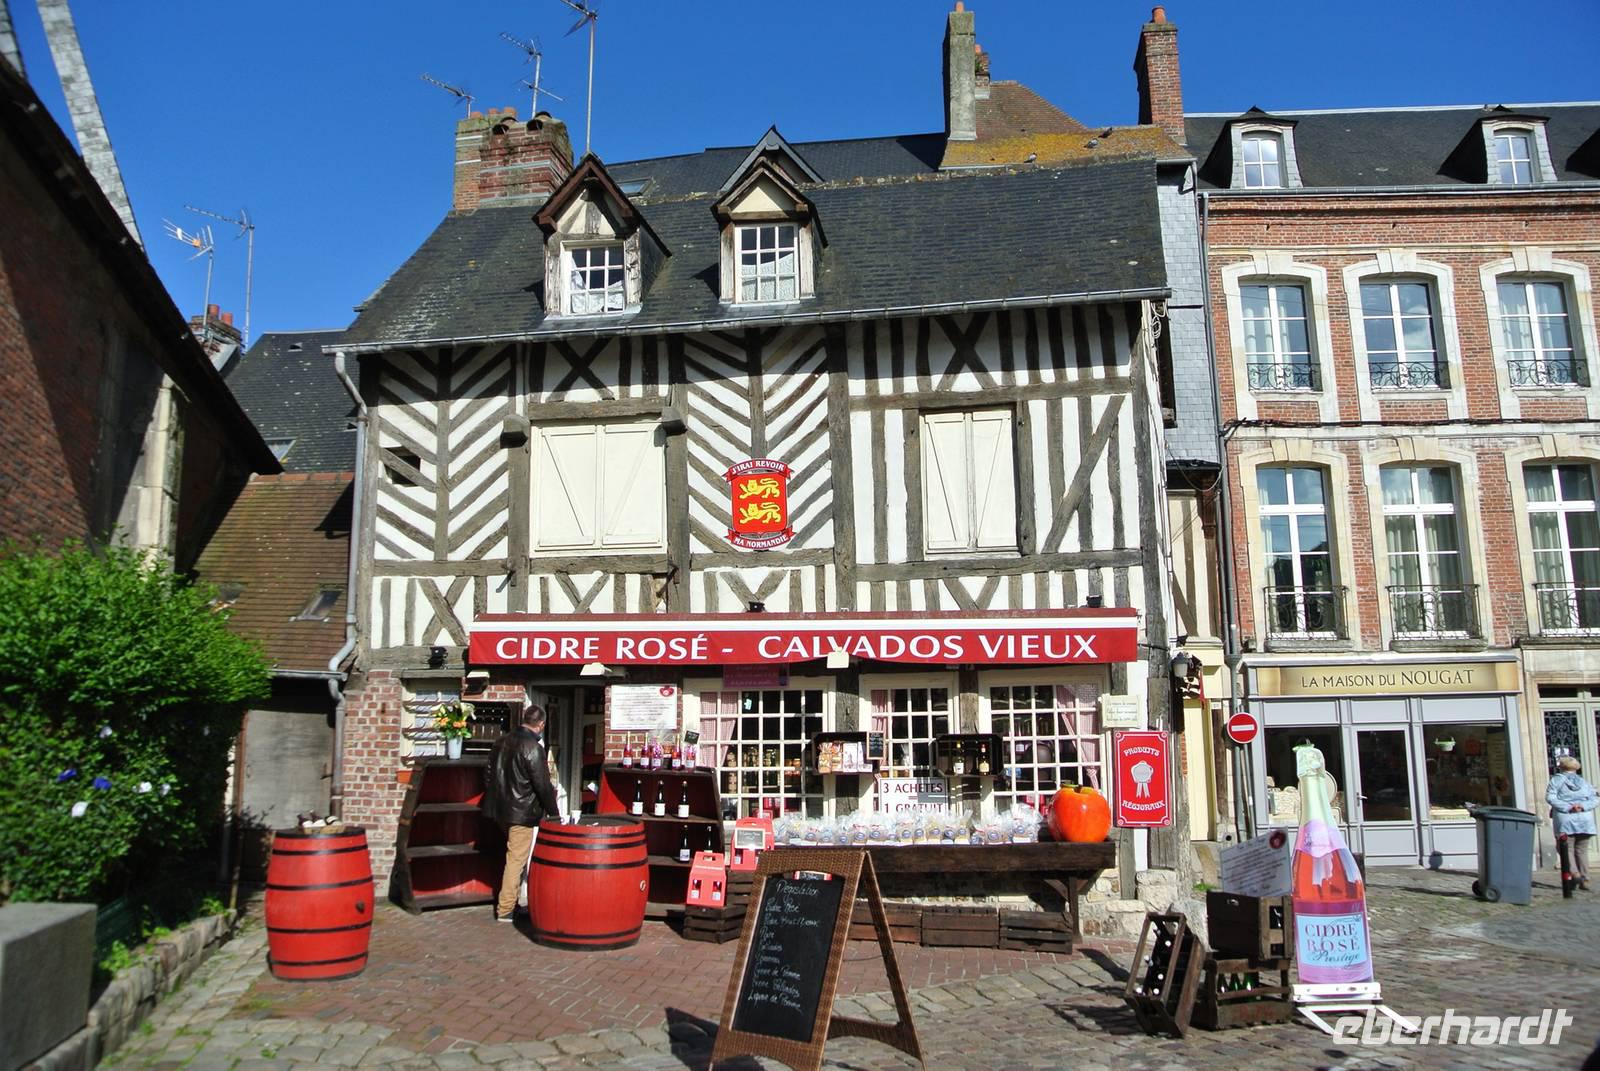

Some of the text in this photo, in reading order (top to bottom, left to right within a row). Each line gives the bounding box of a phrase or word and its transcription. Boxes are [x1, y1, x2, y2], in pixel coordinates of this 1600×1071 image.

[731, 460, 785, 473] J'IRAI REVOIR
[734, 535, 788, 548] MA NORMANDIE
[496, 637, 600, 659] CIDRE
[616, 634, 708, 660] ROSÉ
[758, 635, 964, 658] CALVADOS
[978, 634, 1098, 658] VIEUX
[1302, 669, 1474, 688] LA MAISON DU NOUGAT
[883, 783, 889, 794] 3
[884, 803, 889, 814] 1
[1305, 924, 1357, 937] CIDRE
